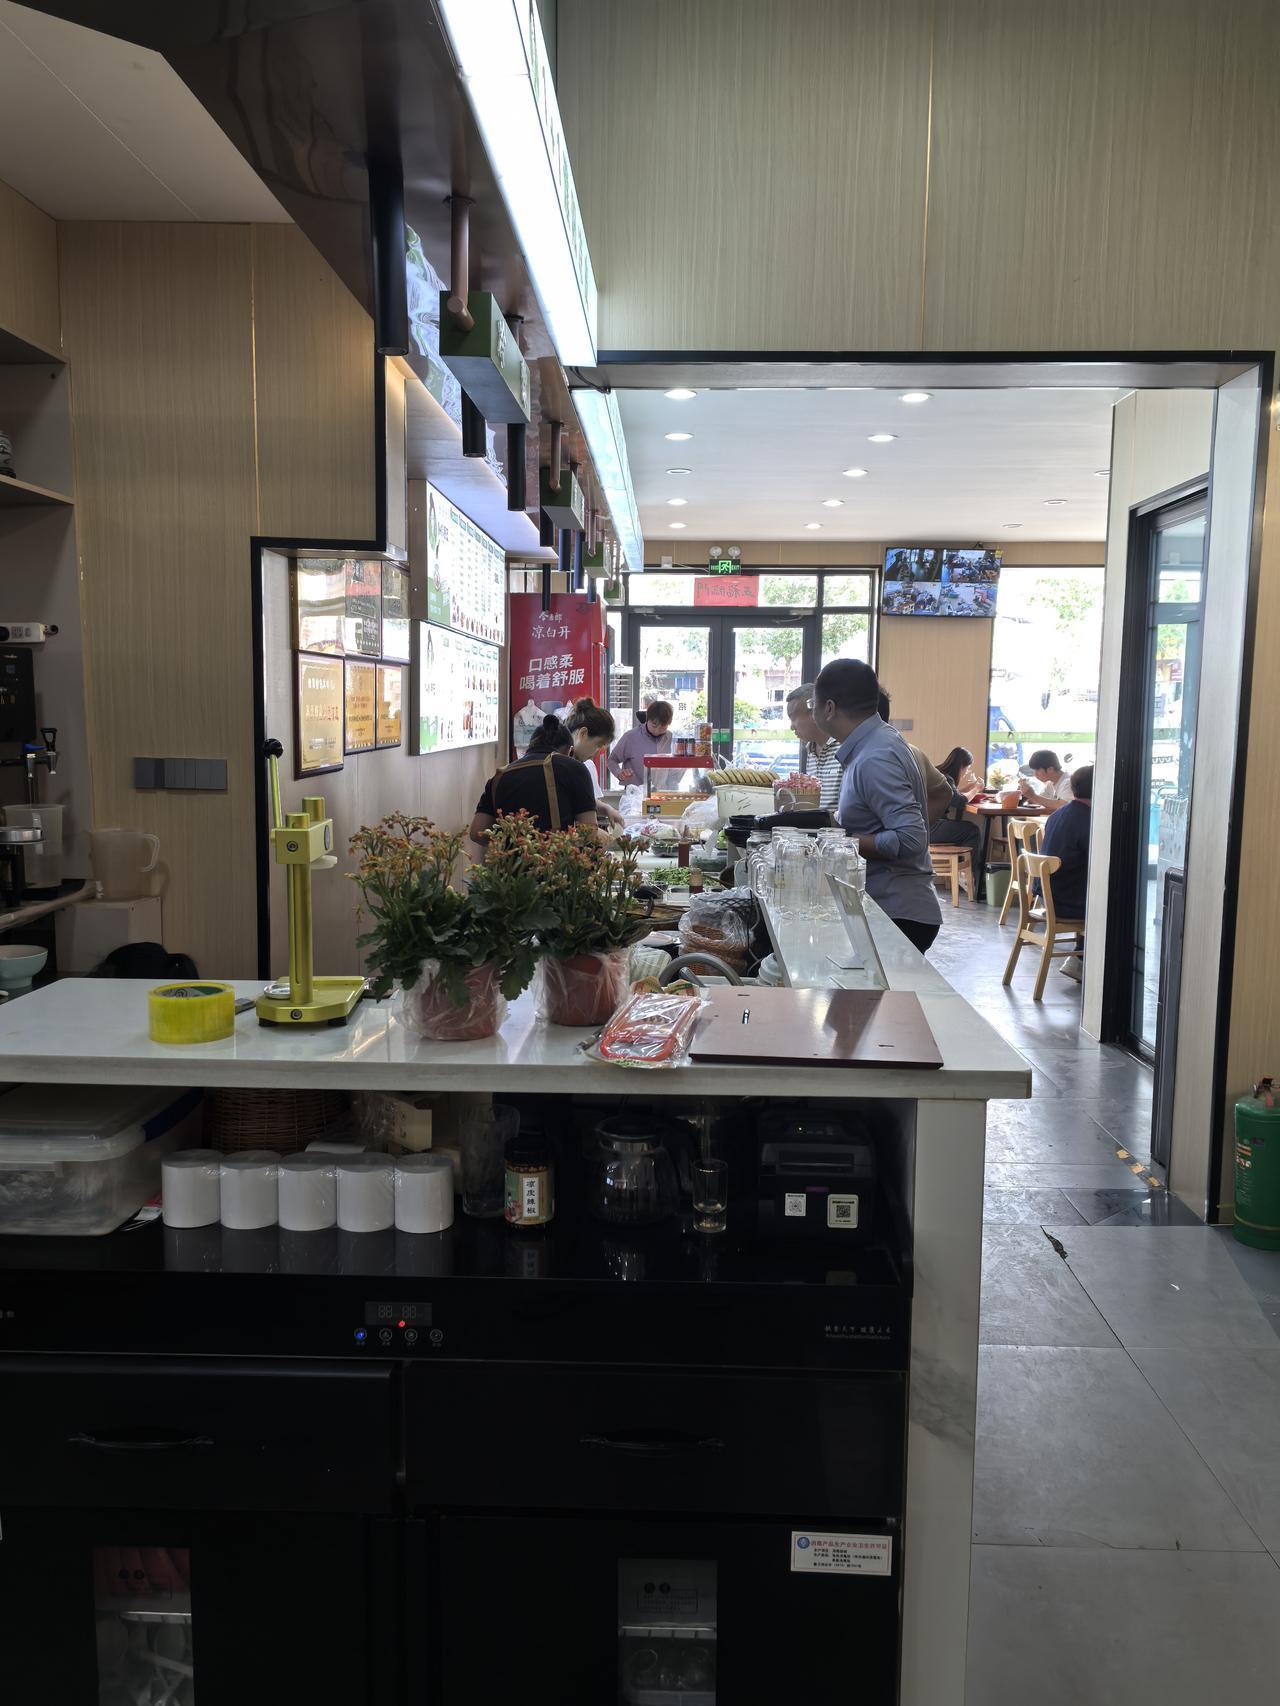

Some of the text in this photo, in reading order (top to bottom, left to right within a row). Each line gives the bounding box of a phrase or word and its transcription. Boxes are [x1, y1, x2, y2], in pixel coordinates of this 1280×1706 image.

[528, 653, 574, 672] 口感柔
[519, 668, 585, 690] 喝着舒服
